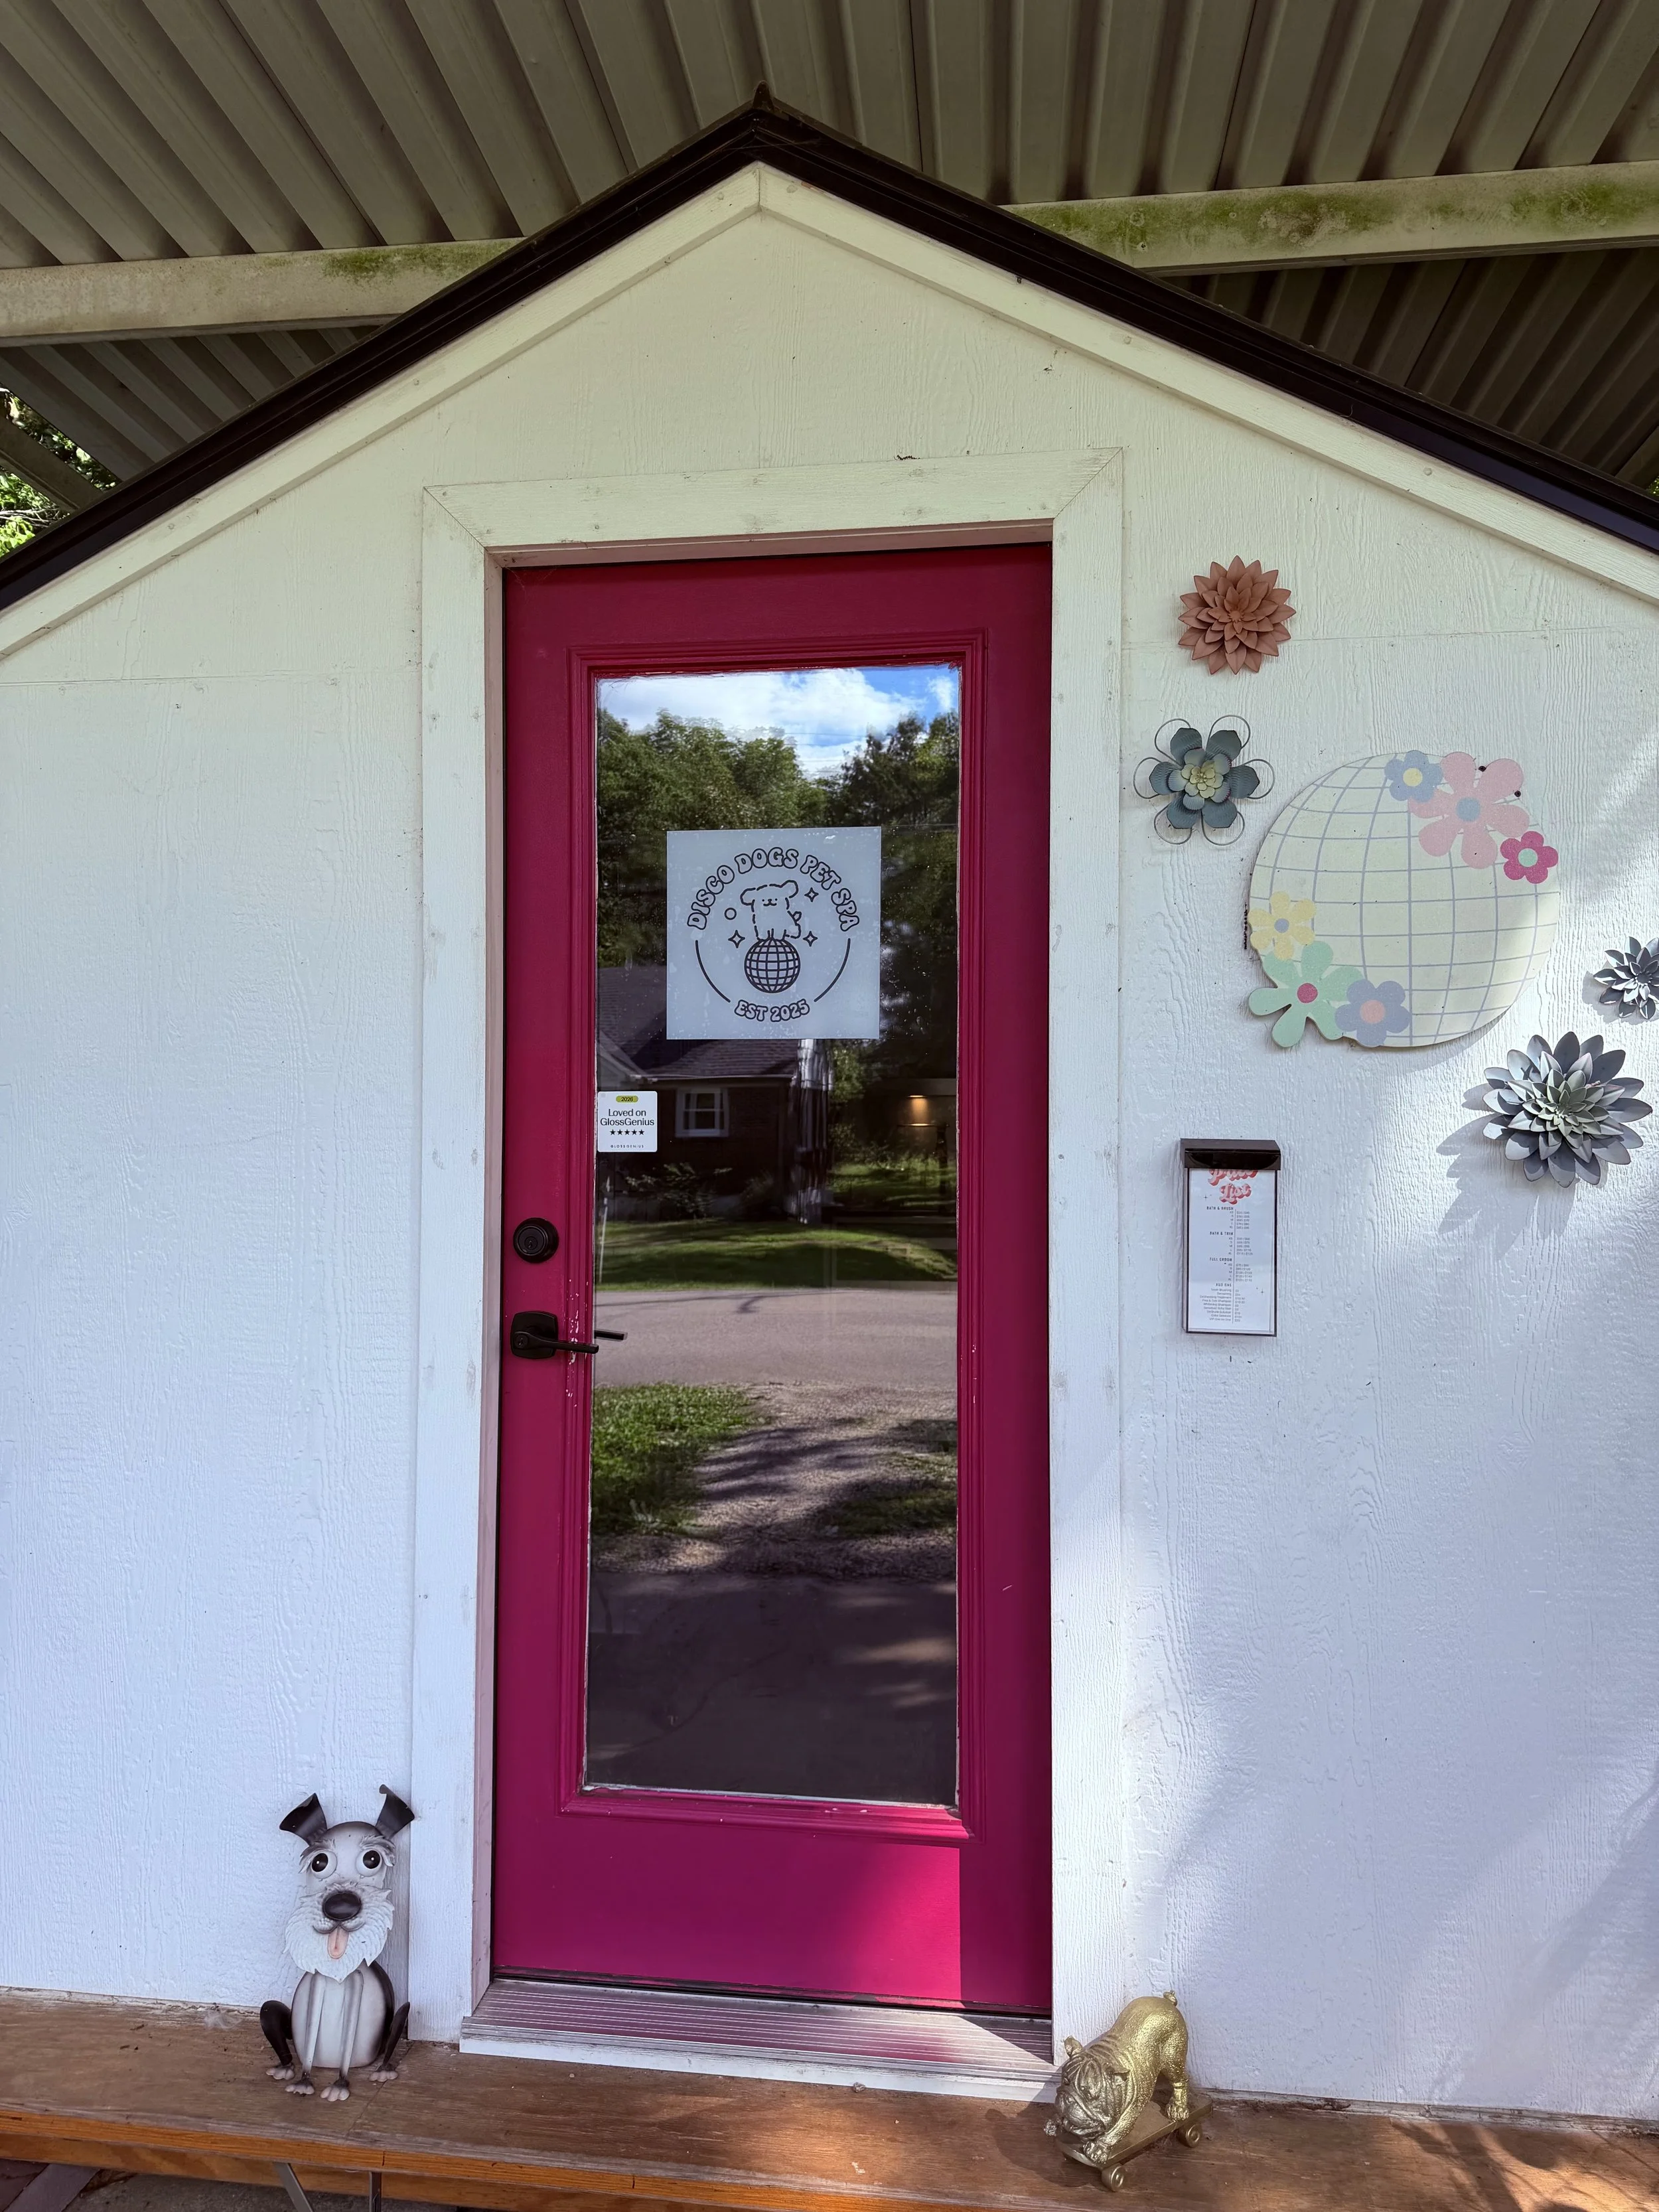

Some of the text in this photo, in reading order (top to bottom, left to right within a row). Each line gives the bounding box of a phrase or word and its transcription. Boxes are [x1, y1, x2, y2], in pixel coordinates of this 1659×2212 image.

[687, 846, 859, 932] DISCO DOGS PET SPA
[735, 998, 810, 1023] EST 2025
[600, 1118, 654, 1126] GlossGenius
[1219, 1183, 1252, 1205] List
